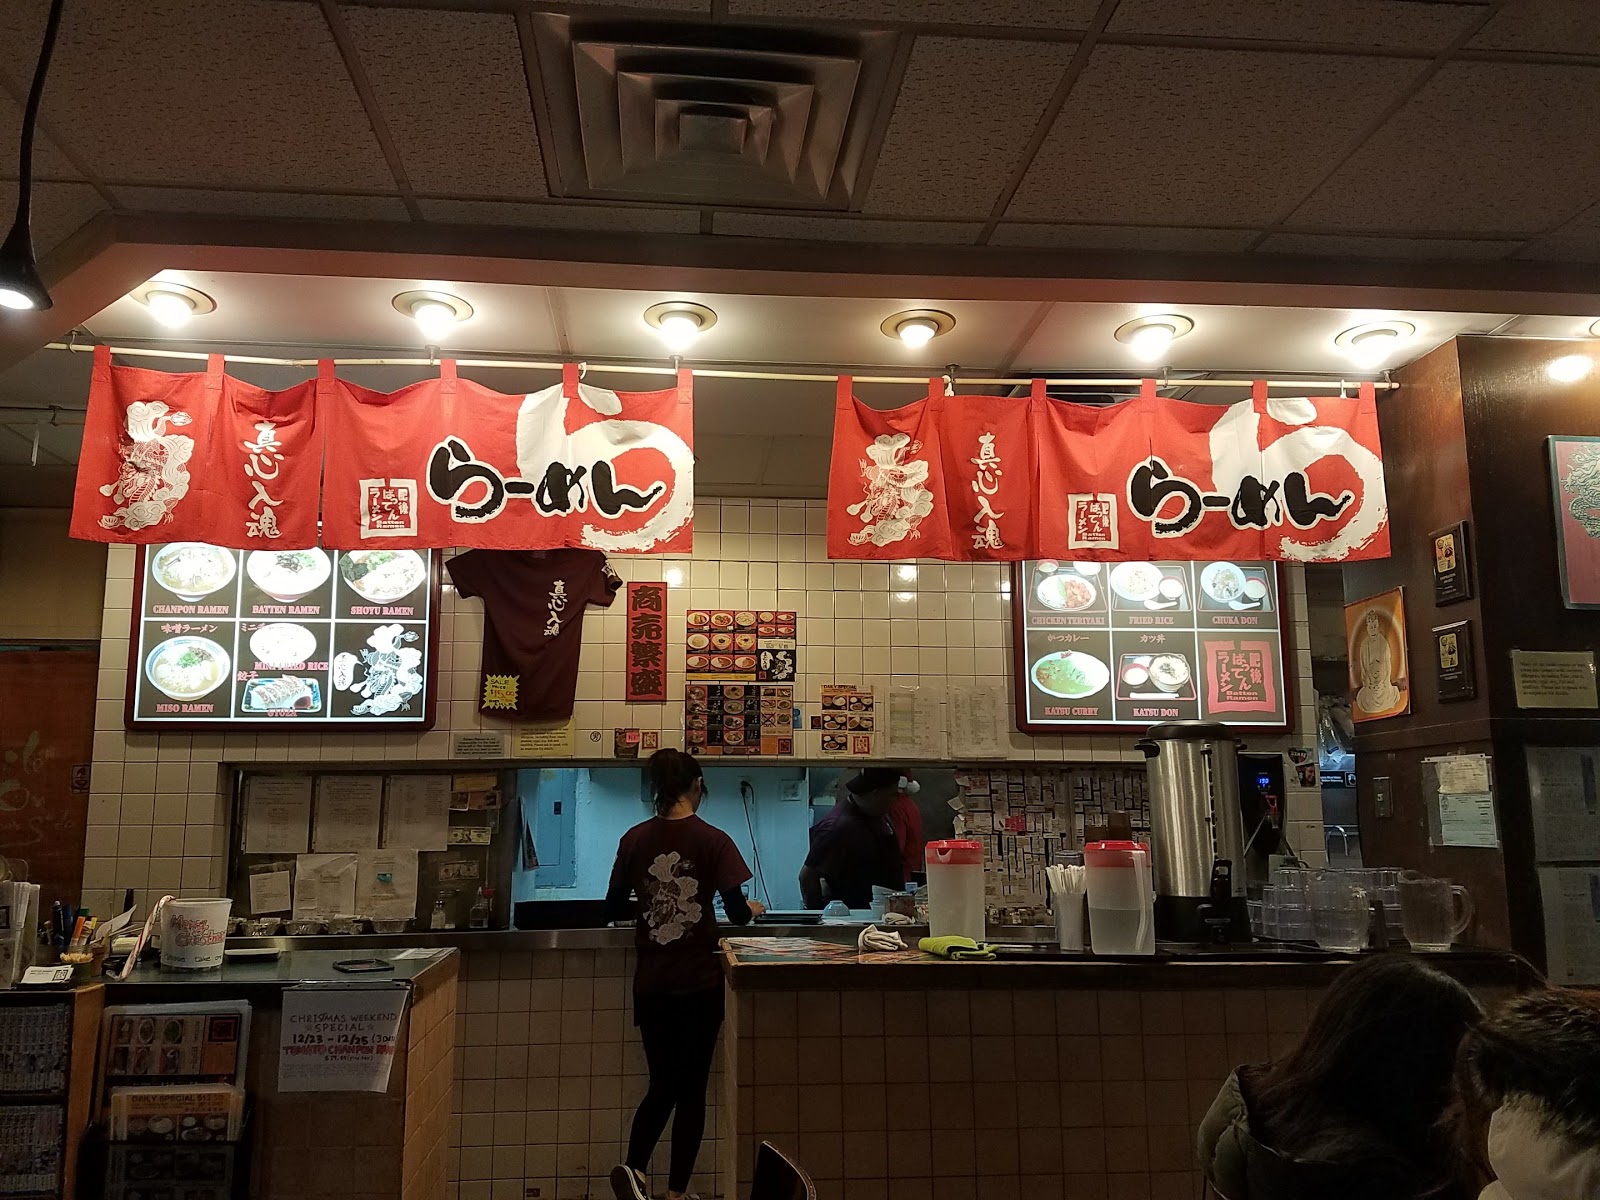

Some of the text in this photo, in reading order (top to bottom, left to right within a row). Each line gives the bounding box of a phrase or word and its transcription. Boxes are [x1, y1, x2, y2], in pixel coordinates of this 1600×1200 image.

[244, 420, 284, 539] 真心入魂
[428, 437, 665, 521] らーめん
[970, 431, 1005, 550] 真心入魂
[1129, 457, 1353, 535] らーめん
[152, 604, 230, 615] CHANPON RAMEN
[252, 605, 321, 615] BATTEN RAMEN
[350, 606, 414, 615] SHOYU RAMEN
[1031, 616, 1105, 625] CHICKEN TERIYAKI
[1128, 616, 1174, 625] FRIED RICE
[1212, 616, 1258, 624] CHUKA DON
[1047, 633, 1090, 643] かつカレー
[307, 662, 329, 671] RICE
[1217, 652, 1233, 693] ラーメン
[1231, 653, 1252, 691] ばってん
[156, 703, 214, 713] MISO RAMEN
[1044, 707, 1099, 715] KATSU CURRY
[1133, 708, 1179, 717] KATSU DON
[350, 1013, 398, 1022] WEEKEND
[314, 1023, 365, 1033] SPECIAL
[292, 1034, 324, 1044] 12/23
[337, 1034, 369, 1045] 12/25
